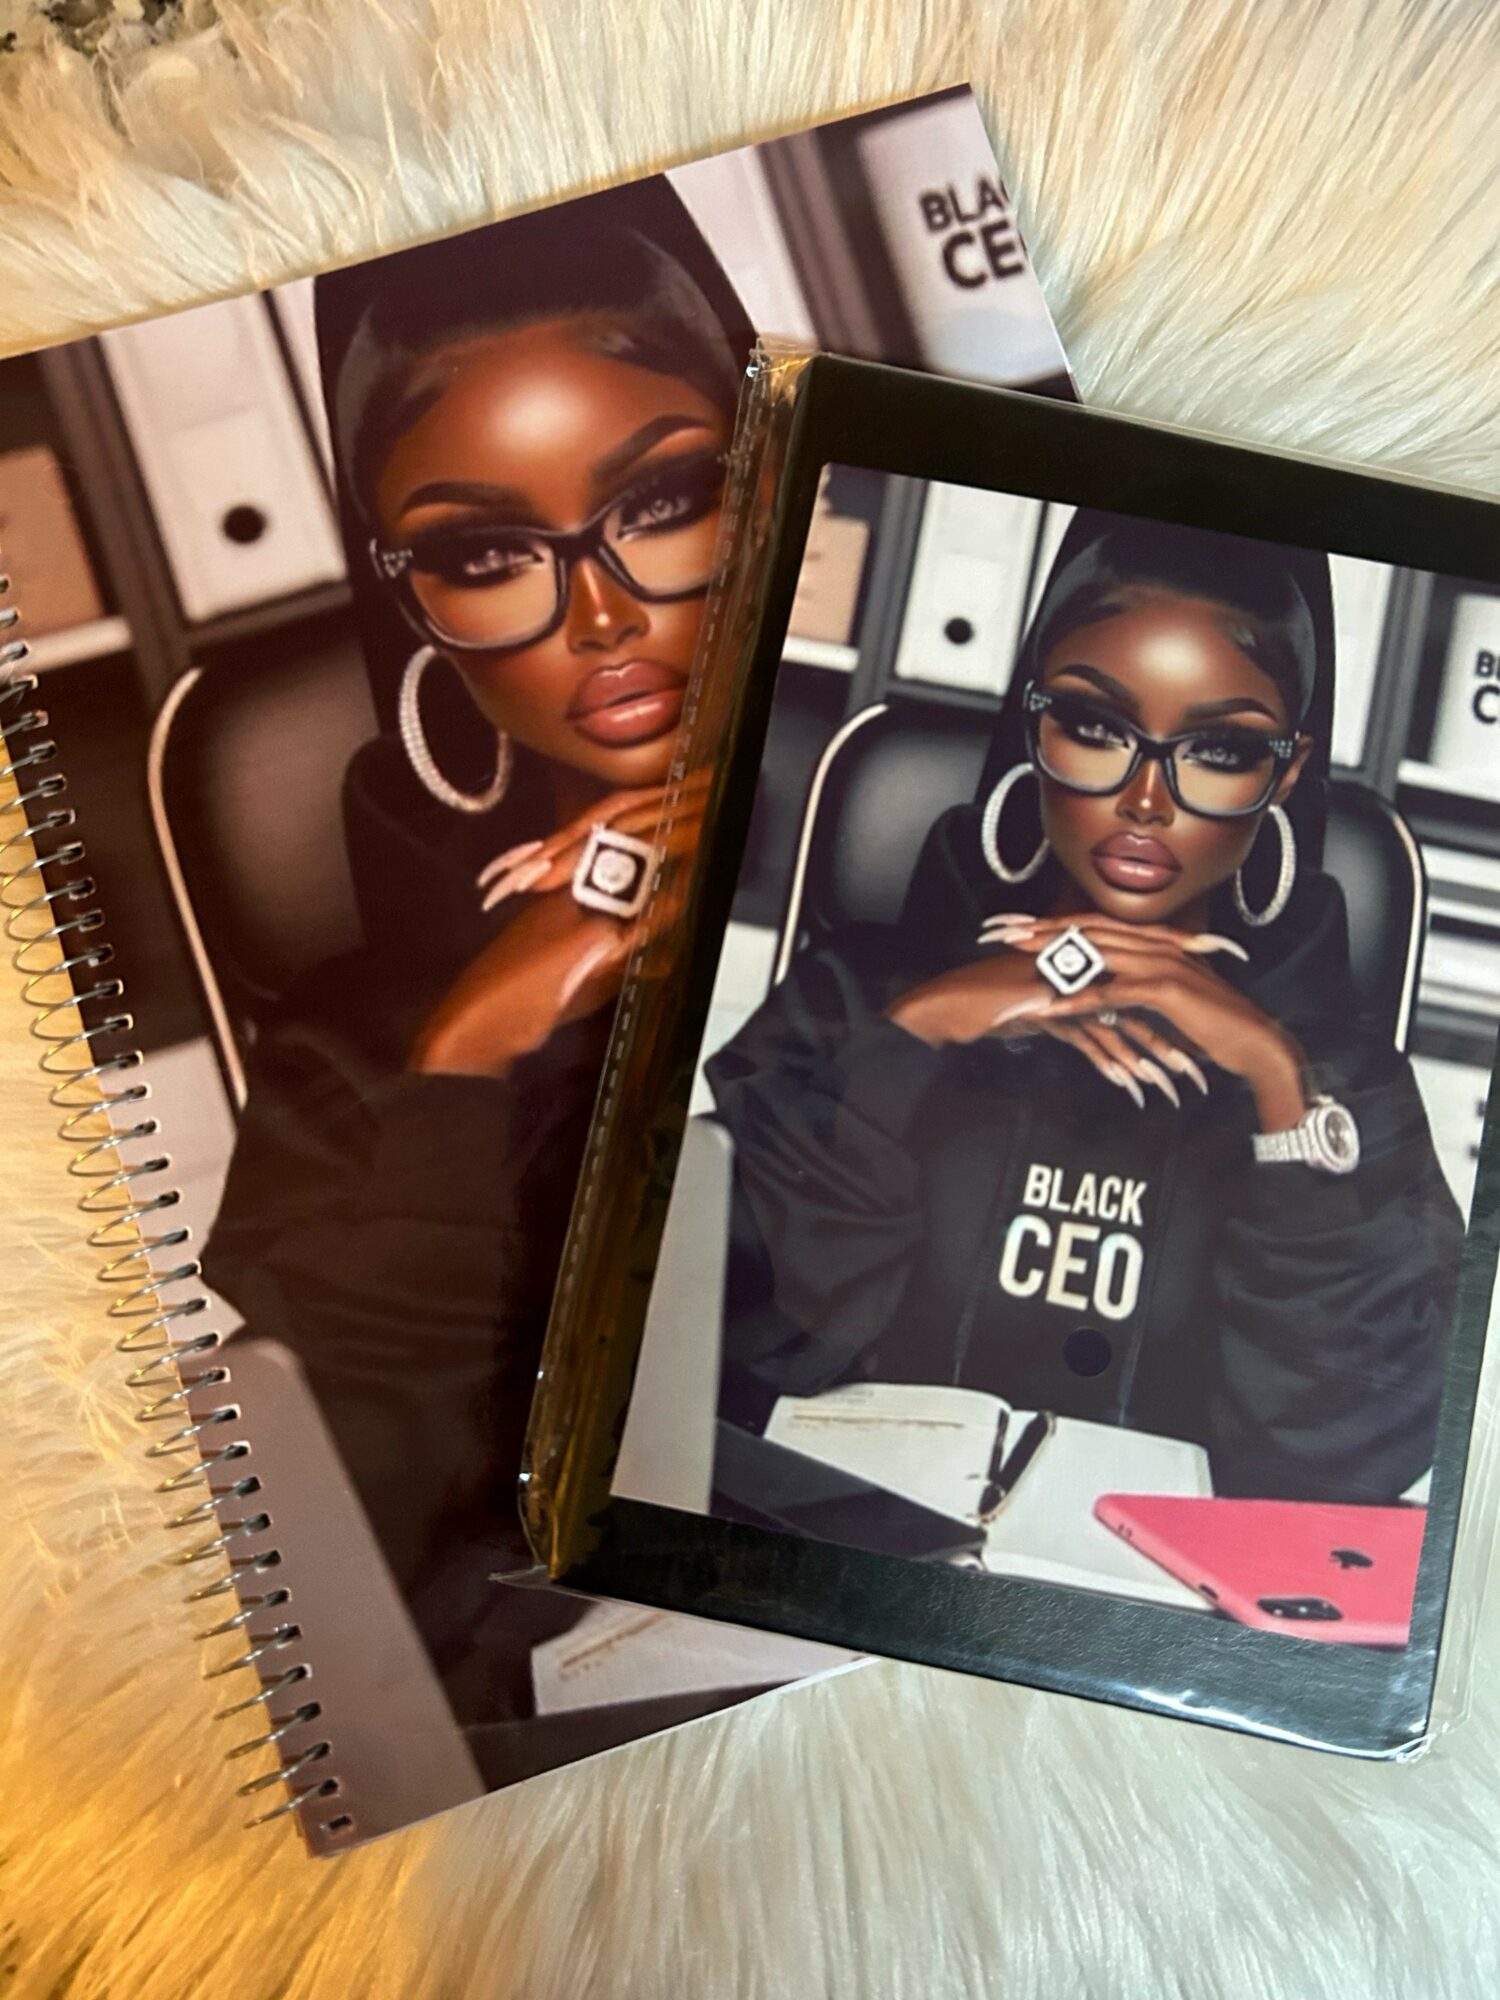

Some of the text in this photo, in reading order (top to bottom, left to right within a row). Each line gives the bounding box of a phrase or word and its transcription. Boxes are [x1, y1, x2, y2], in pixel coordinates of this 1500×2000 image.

[919, 175, 1010, 232] BLA
[942, 218, 1028, 289] CE
[1023, 1163, 1147, 1227] BLACK
[999, 1213, 1144, 1321] CEO
